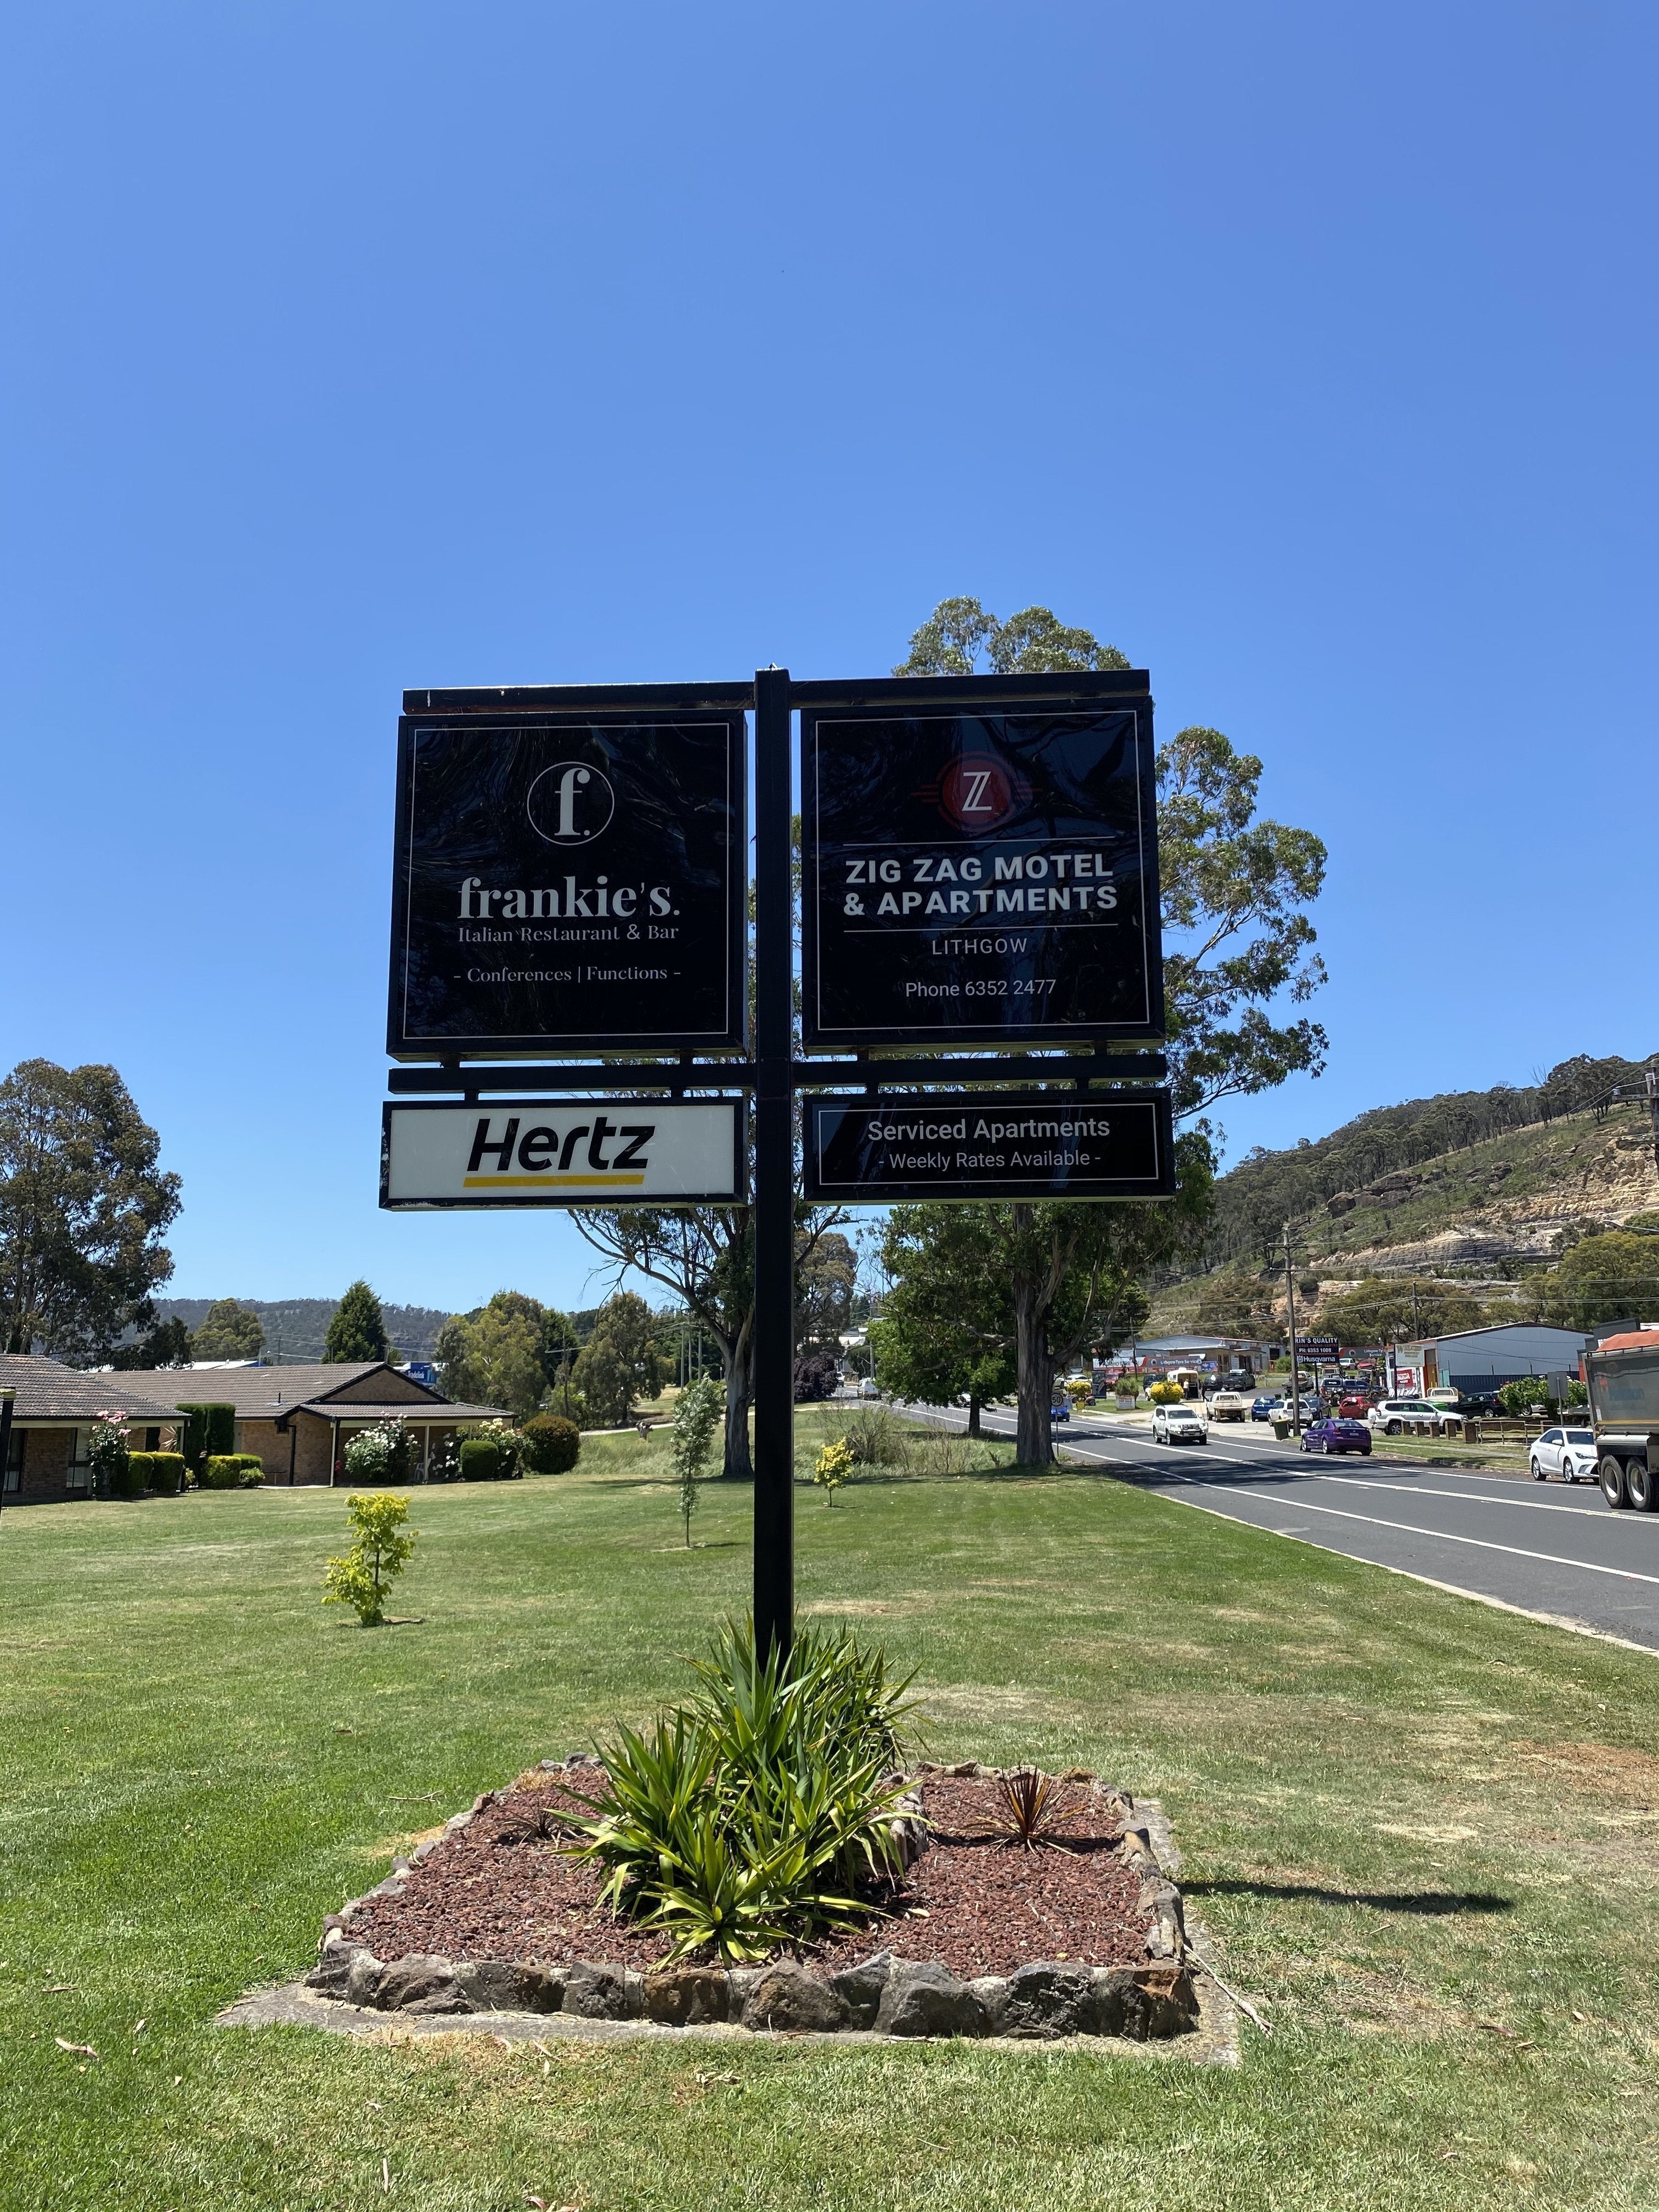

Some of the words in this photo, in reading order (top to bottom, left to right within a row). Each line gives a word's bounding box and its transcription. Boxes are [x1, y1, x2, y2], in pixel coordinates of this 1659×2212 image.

[845, 860, 901, 883] ZIG
[913, 857, 982, 882] ZAG
[995, 853, 1114, 882] MOTEL
[457, 875, 680, 919] frankie's.
[843, 893, 865, 916] &
[877, 885, 1118, 915] APARTMENTS
[458, 927, 513, 942] Italian
[521, 925, 620, 941] Restaurant
[627, 923, 640, 940] &
[648, 925, 679, 939] Bar
[932, 938, 1028, 955] LITHGOW
[467, 967, 572, 982] Conferences
[587, 966, 667, 980] Functions
[906, 981, 960, 997] Phone
[965, 980, 1008, 996] 6352
[1013, 979, 1056, 995] 2477
[868, 1118, 966, 1141] Serviced
[973, 1118, 1110, 1143] Apartments
[467, 1116, 656, 1172] Hertz
[889, 1152, 951, 1172] Weekly
[956, 1152, 1005, 1167] Rates
[1010, 1150, 1090, 1166] Available
